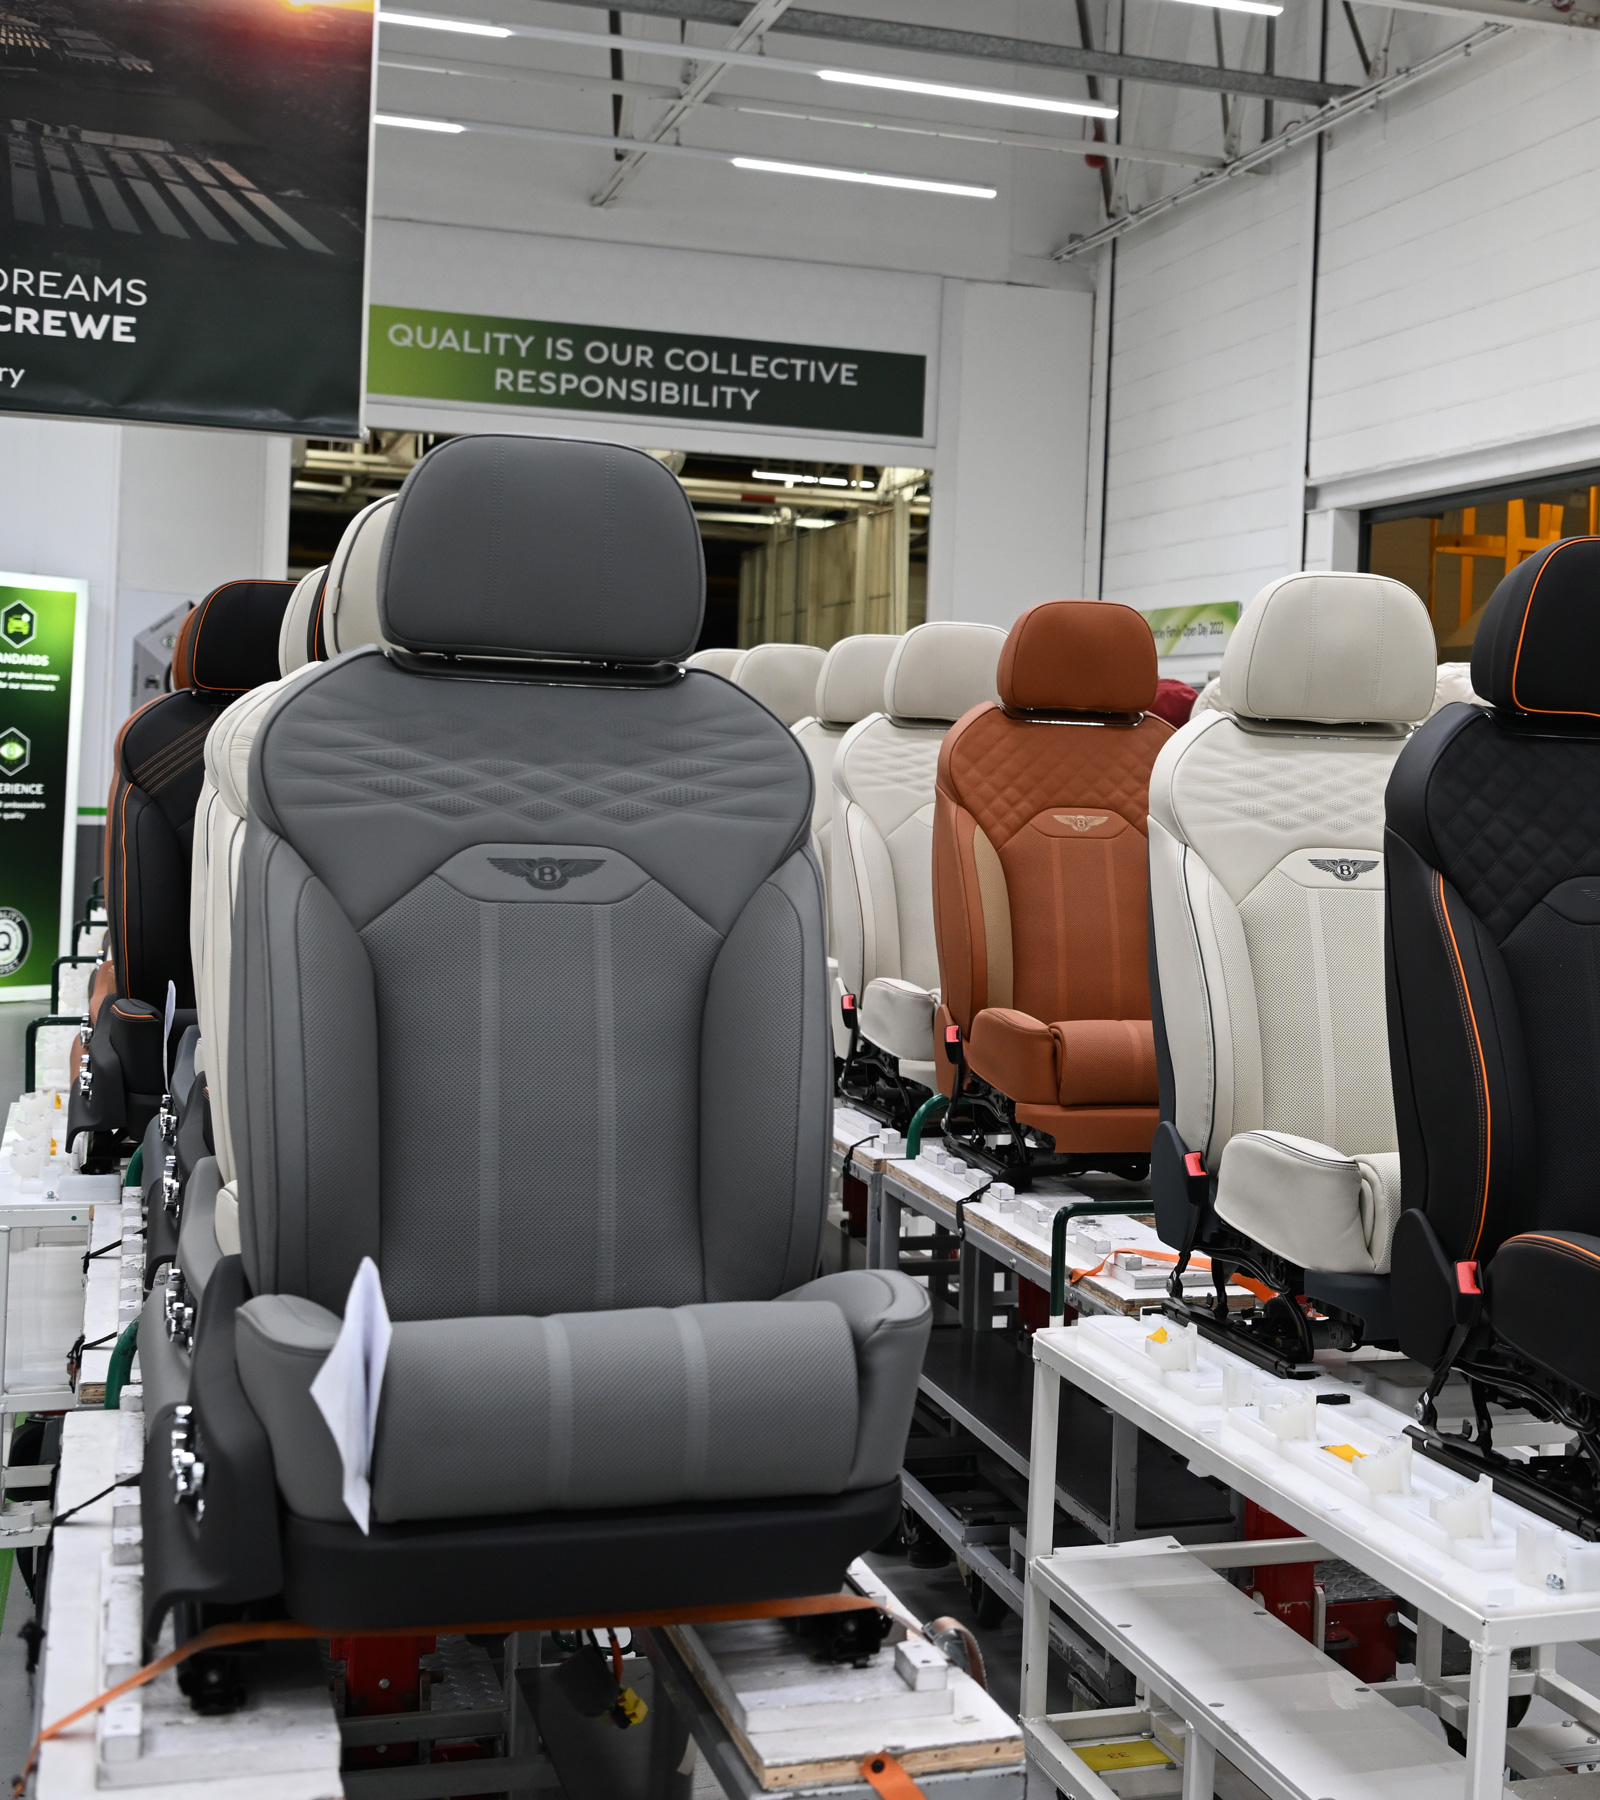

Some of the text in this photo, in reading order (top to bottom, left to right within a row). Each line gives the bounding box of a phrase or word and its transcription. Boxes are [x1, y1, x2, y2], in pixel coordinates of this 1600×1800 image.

[388, 323, 858, 386] QUALITY IS OUR COLLECTIVE
[495, 368, 760, 411] RESPONSIBILITY
[1210, 621, 1224, 635] 2022
